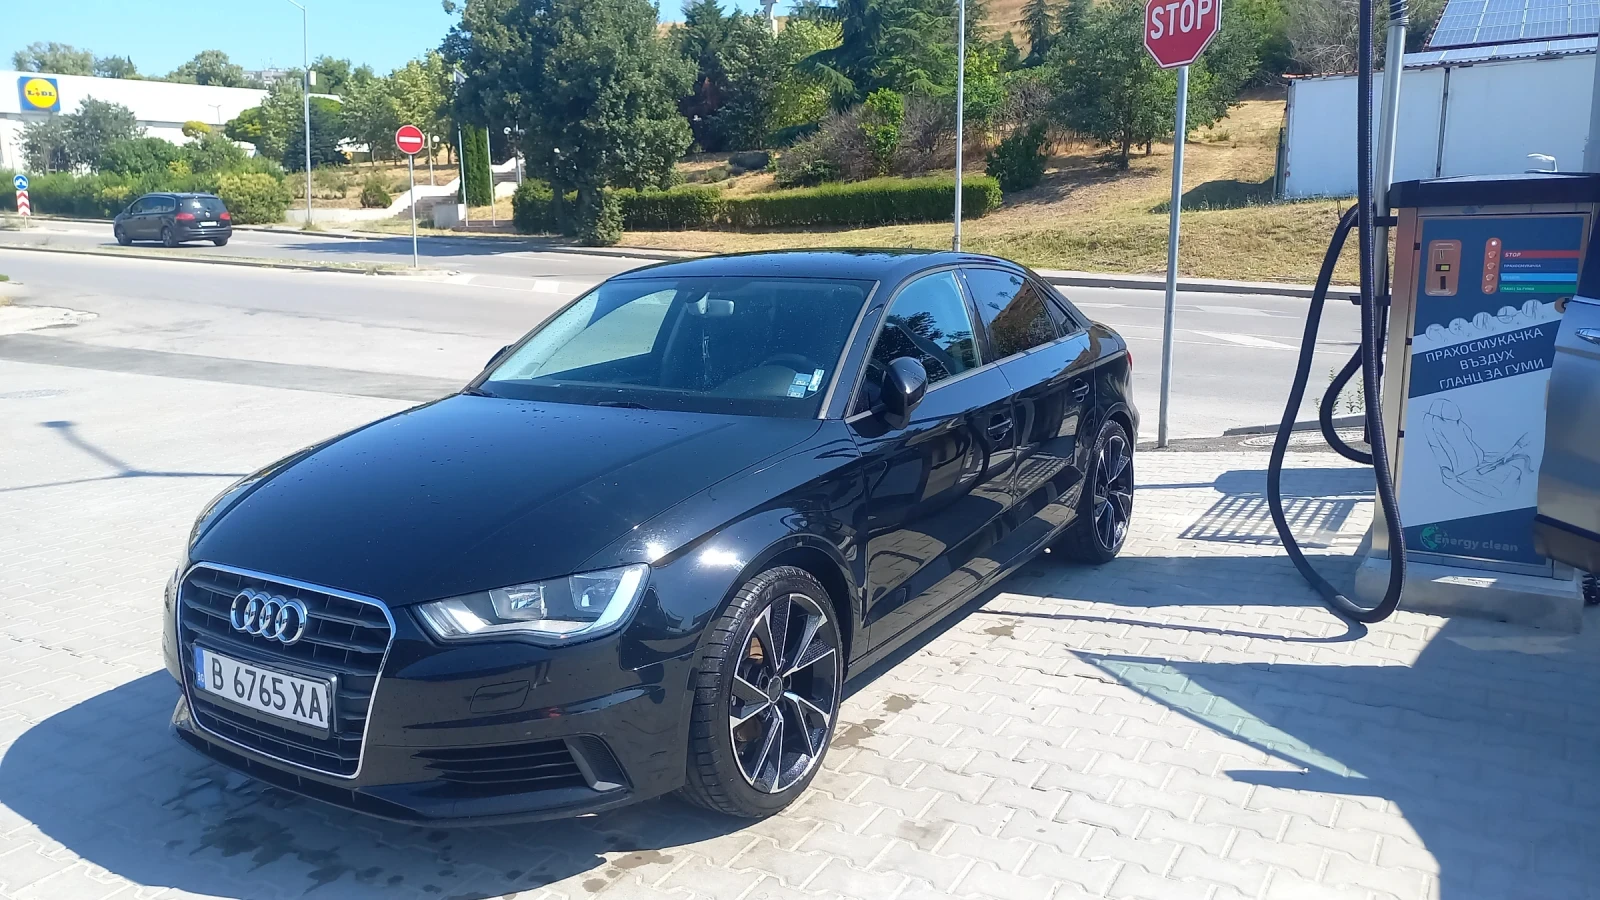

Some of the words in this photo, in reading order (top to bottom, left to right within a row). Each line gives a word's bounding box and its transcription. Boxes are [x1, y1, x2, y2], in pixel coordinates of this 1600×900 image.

[1150, 0, 1213, 40] STOP
[1425, 327, 1544, 362] ПРАХОСМУКАЧКА
[1459, 349, 1515, 370] ВЪЗДУХ
[1439, 371, 1484, 389] ГЛАНЦ
[1485, 367, 1503, 379] ЗА
[1505, 358, 1545, 375] ГУМИ
[1434, 533, 1479, 550] Energy
[1482, 540, 1518, 552] clean
[211, 657, 224, 690] B
[234, 666, 286, 711] 6765
[290, 681, 323, 722] XA
